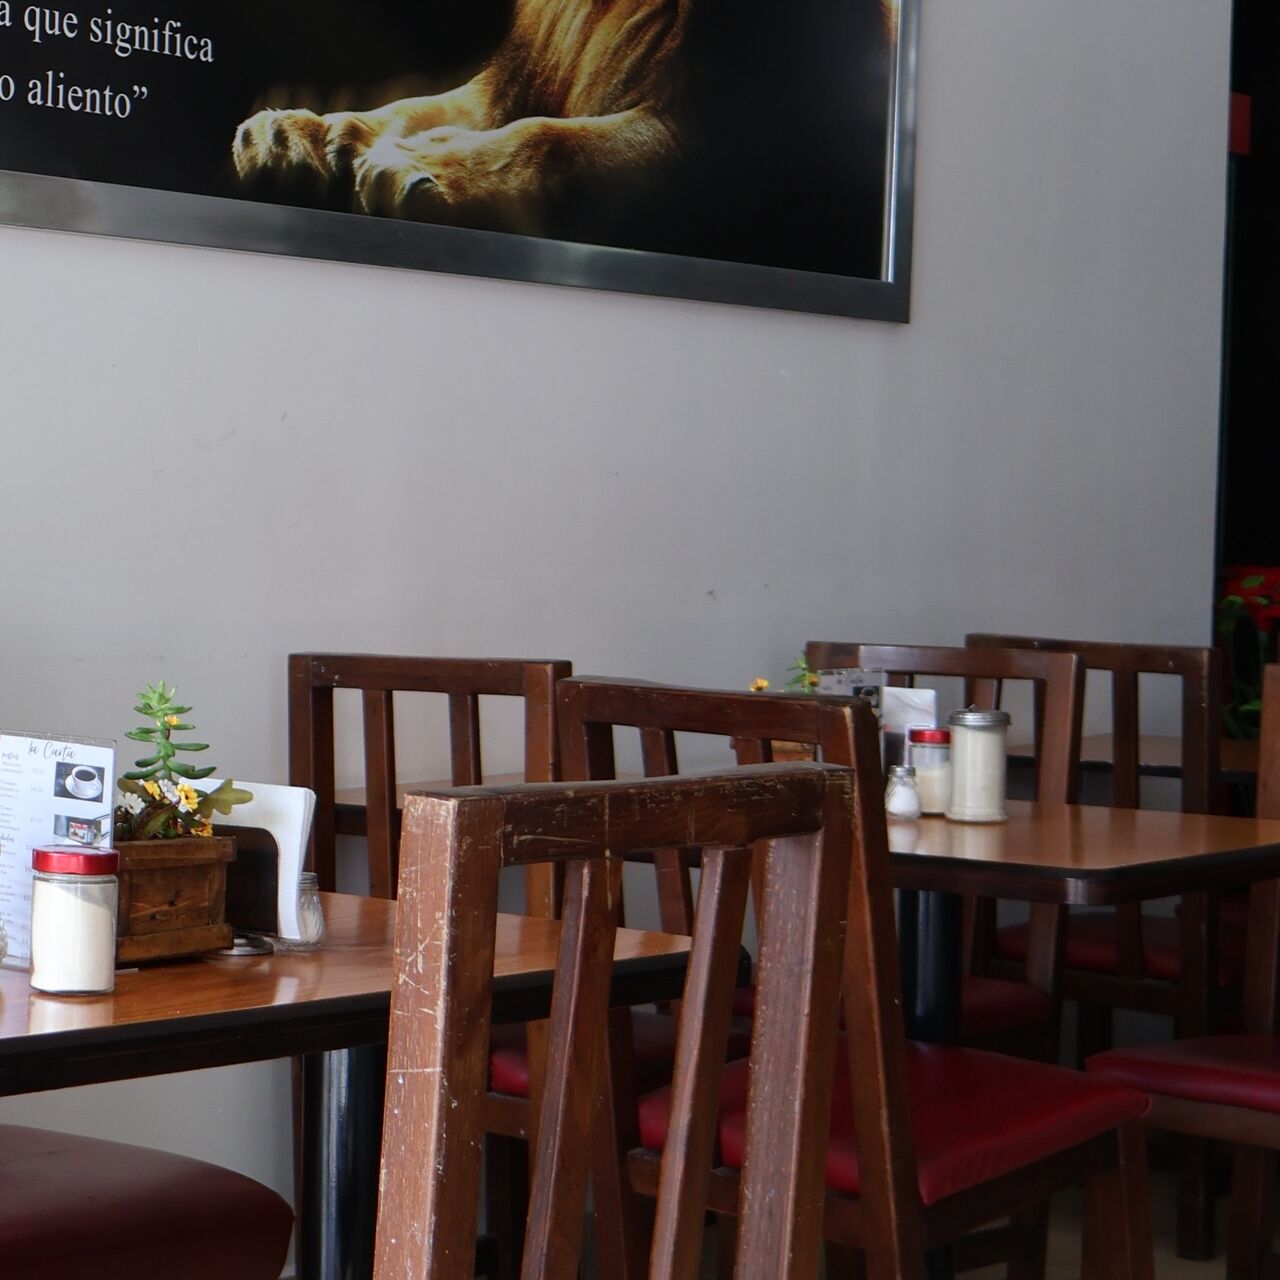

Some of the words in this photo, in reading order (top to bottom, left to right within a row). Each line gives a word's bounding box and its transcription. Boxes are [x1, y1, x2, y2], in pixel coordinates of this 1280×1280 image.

[24, 2, 78, 44] que
[89, 8, 214, 63] significa
[27, 70, 148, 119] aliento”
